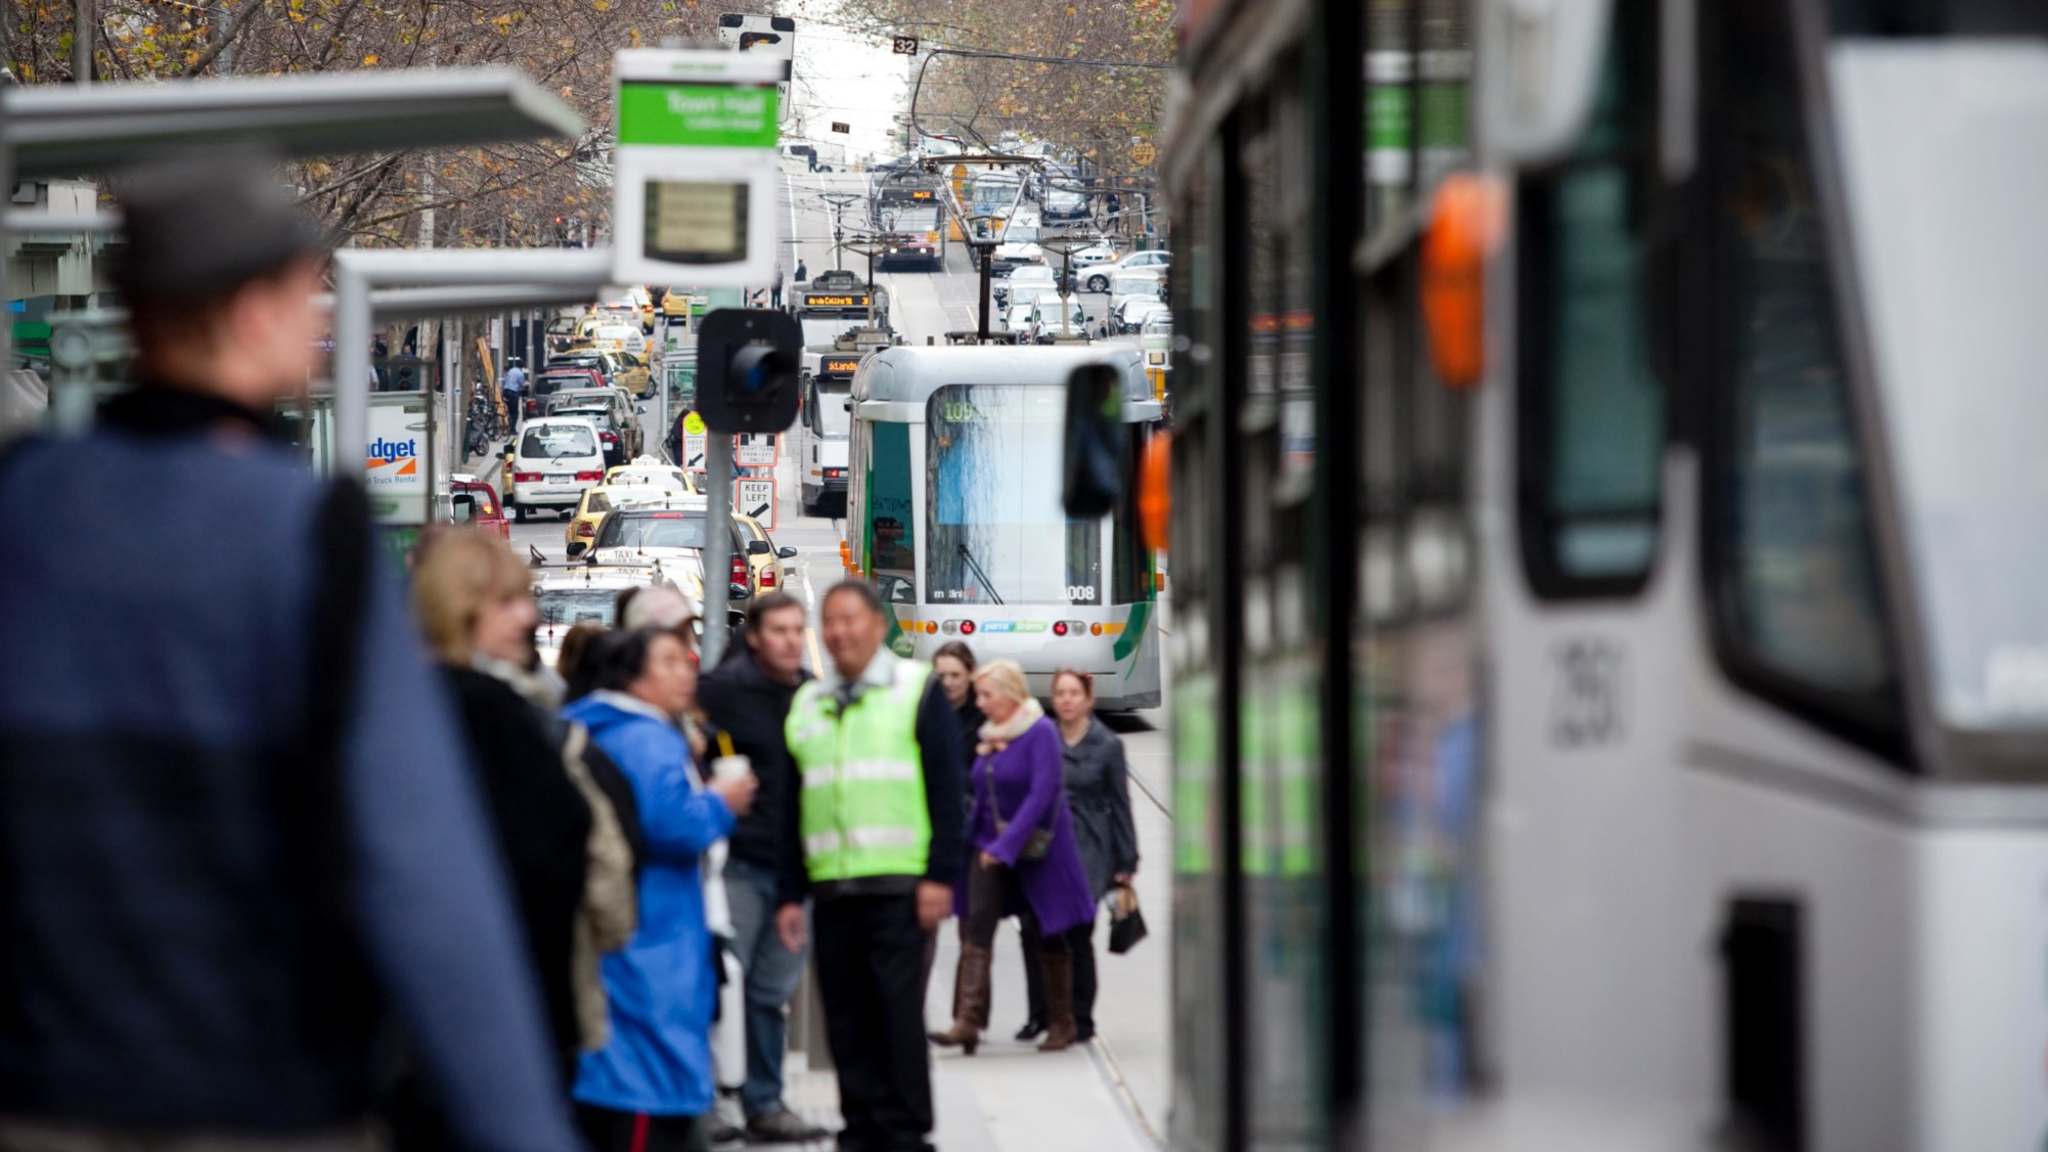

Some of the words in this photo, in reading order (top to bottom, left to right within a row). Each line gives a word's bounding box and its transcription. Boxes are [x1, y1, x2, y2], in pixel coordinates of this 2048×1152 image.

[896, 39, 915, 53] 32
[366, 437, 416, 463] dget
[745, 484, 768, 492] KEEP
[745, 494, 767, 502] LEFT
[614, 550, 633, 559] TAXI
